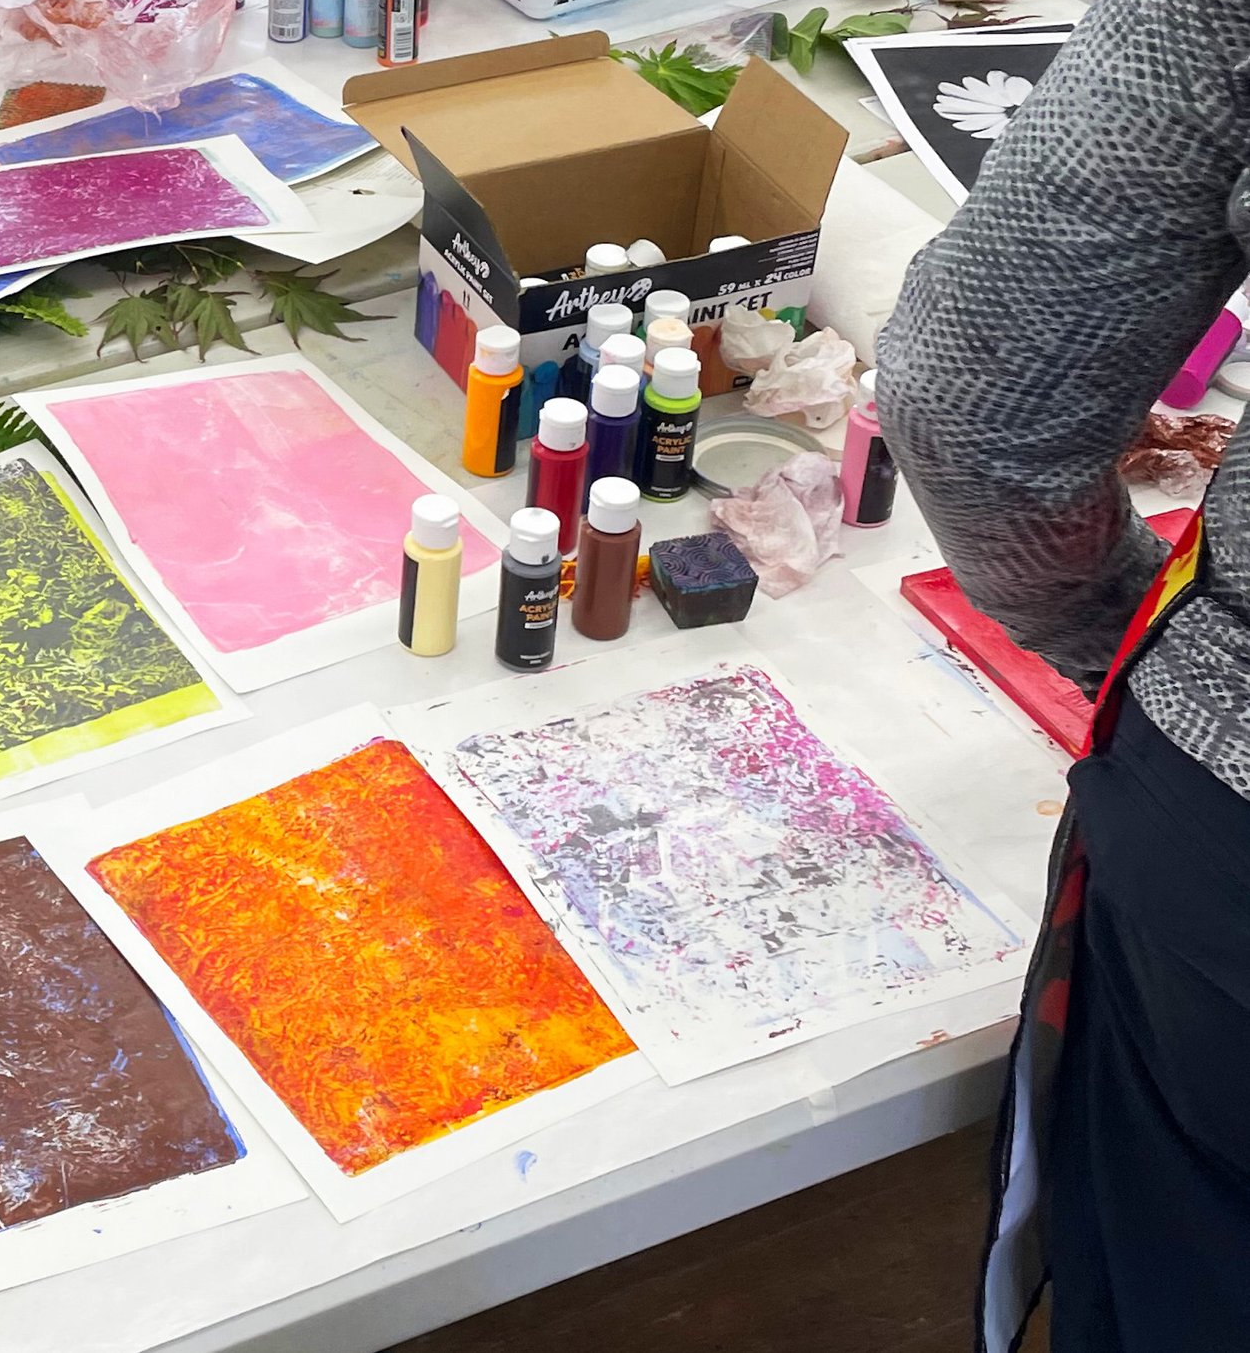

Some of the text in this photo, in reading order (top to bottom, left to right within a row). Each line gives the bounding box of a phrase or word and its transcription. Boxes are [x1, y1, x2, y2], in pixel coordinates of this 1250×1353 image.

[452, 232, 481, 276] Artkey
[717, 282, 737, 296] 59
[764, 270, 782, 284] 24
[783, 267, 812, 281] COLOR
[546, 284, 629, 322] Artkey
[687, 301, 730, 325] INT
[651, 435, 692, 446] ACRYLIC
[656, 446, 687, 455] PAINT
